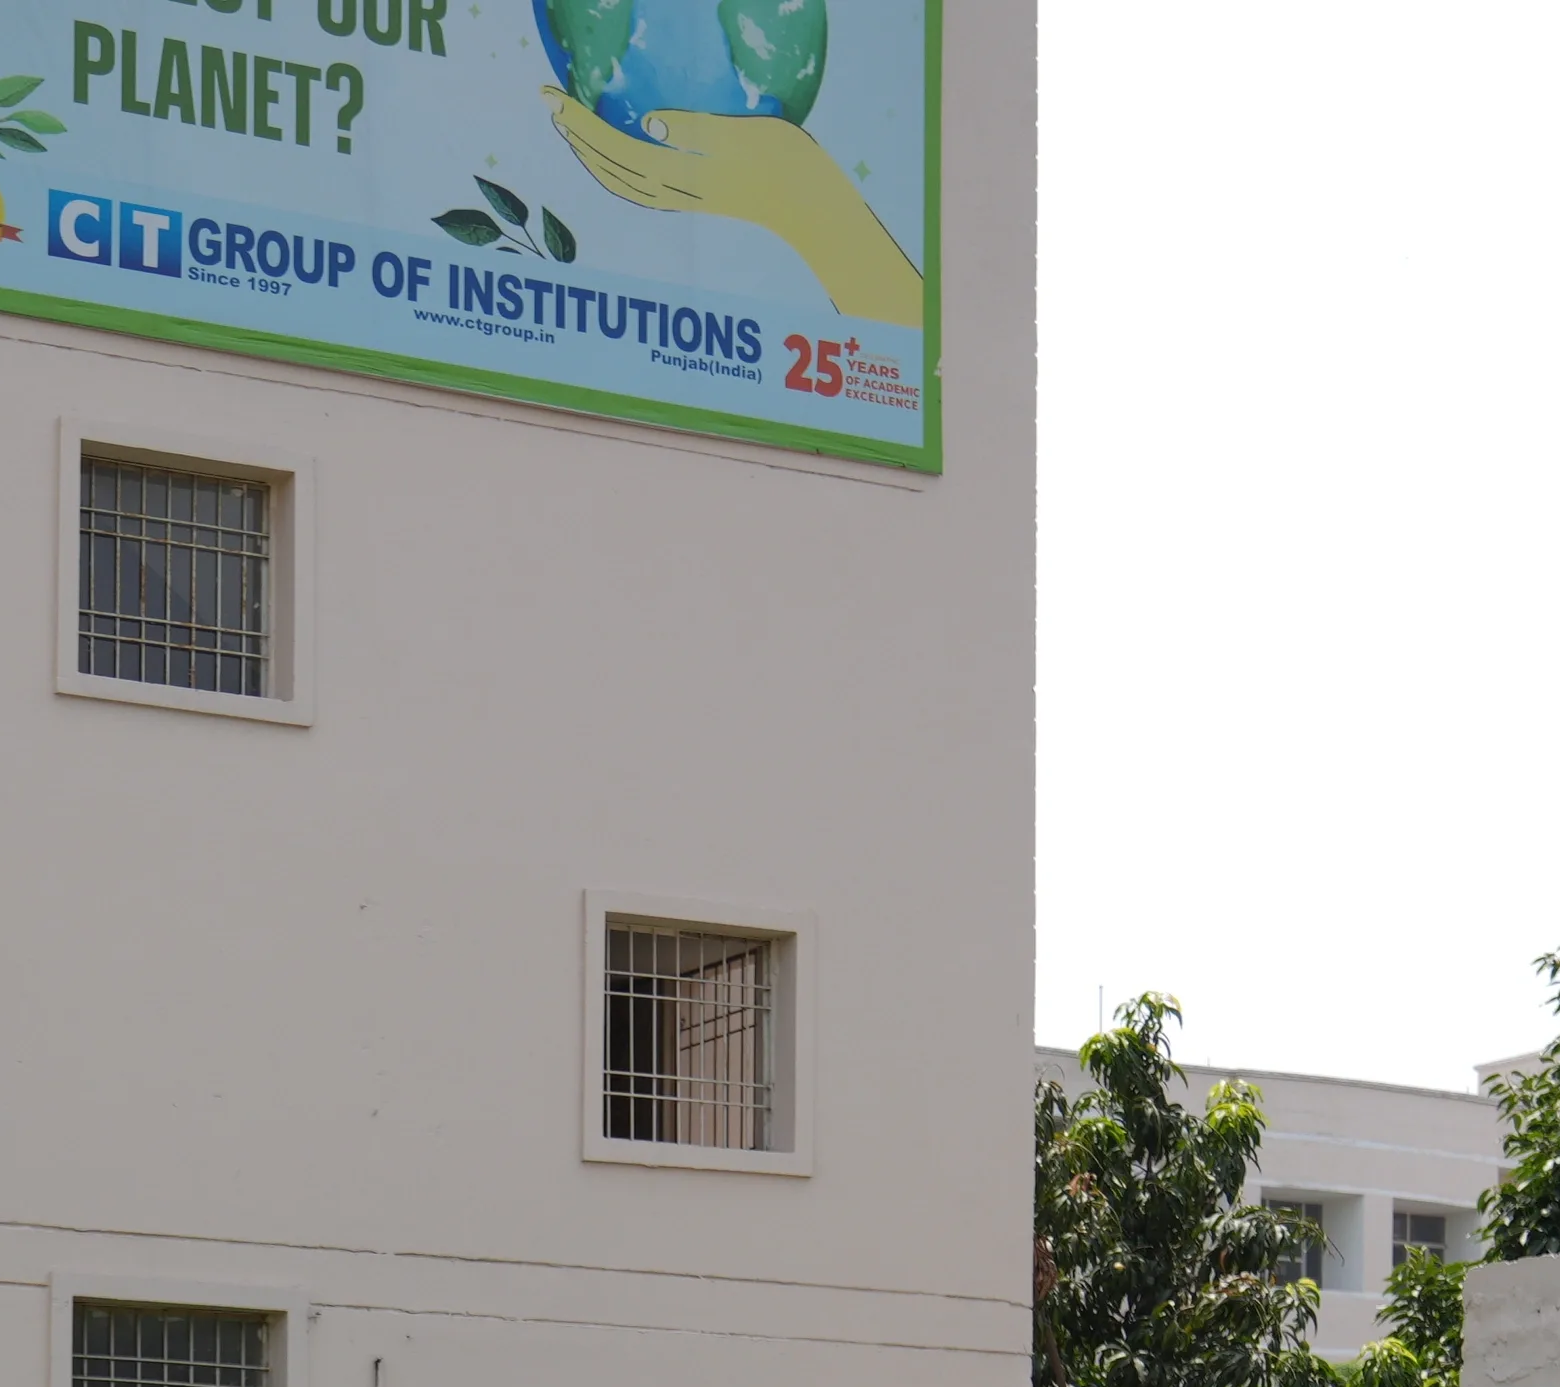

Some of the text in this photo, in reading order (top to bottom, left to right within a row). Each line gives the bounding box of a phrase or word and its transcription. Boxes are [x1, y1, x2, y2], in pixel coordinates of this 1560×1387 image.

[73, 20, 364, 155] PLANET?
[59, 199, 762, 364] CT GROUP OF INSTITUTIONS
[188, 266, 292, 296] Since 1997
[413, 308, 556, 345] www.ctgroup.in
[651, 349, 763, 384] Punjab(India)
[846, 359, 900, 380] YEARS
[845, 375, 921, 397] OF ACADEMIC
[845, 388, 919, 411] EXCELLENCE
